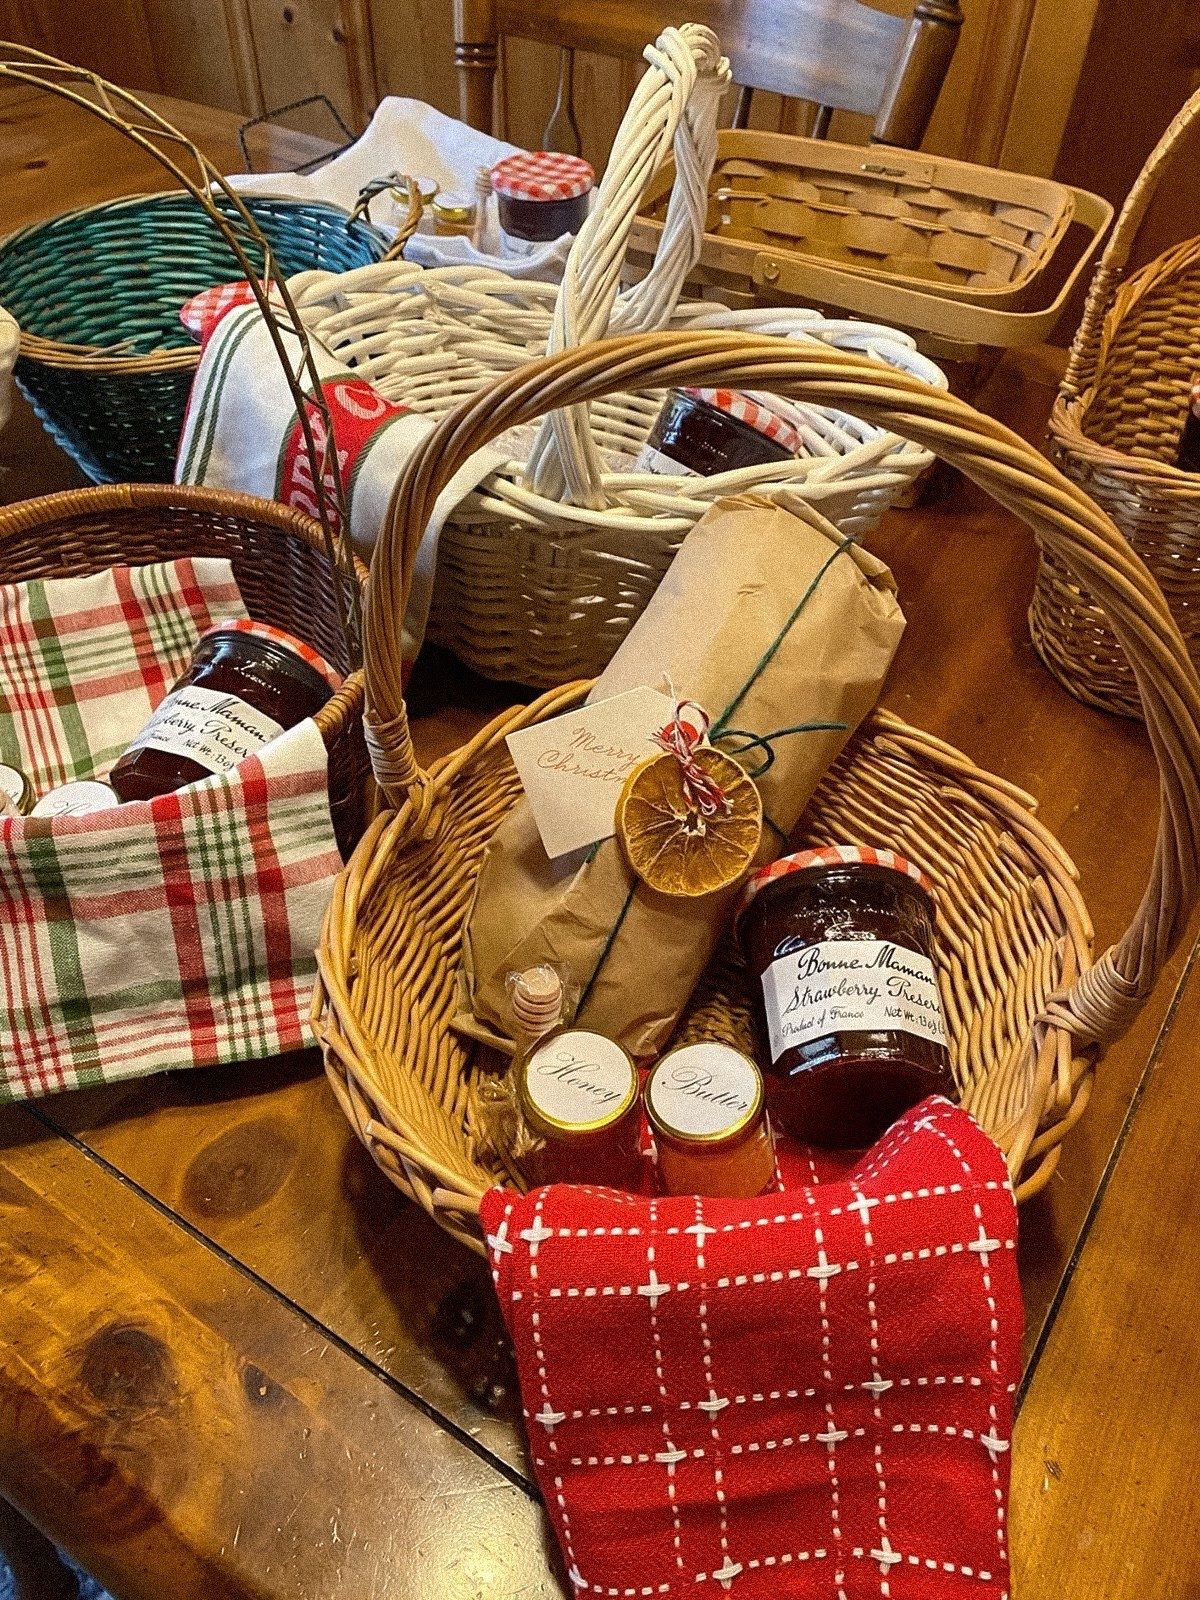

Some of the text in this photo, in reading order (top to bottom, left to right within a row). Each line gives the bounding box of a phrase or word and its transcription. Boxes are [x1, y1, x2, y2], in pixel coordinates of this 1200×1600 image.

[201, 697, 267, 743] Maman
[568, 727, 640, 772] Merry
[797, 945, 937, 987] Bonne Maman
[783, 978, 881, 1017] Strawberry
[781, 1016, 815, 1038] Product
[817, 1009, 827, 1028] of
[829, 1005, 865, 1020] France
[884, 1006, 902, 1017] Net
[536, 1052, 622, 1104] Honey
[661, 1065, 748, 1112] Butter
